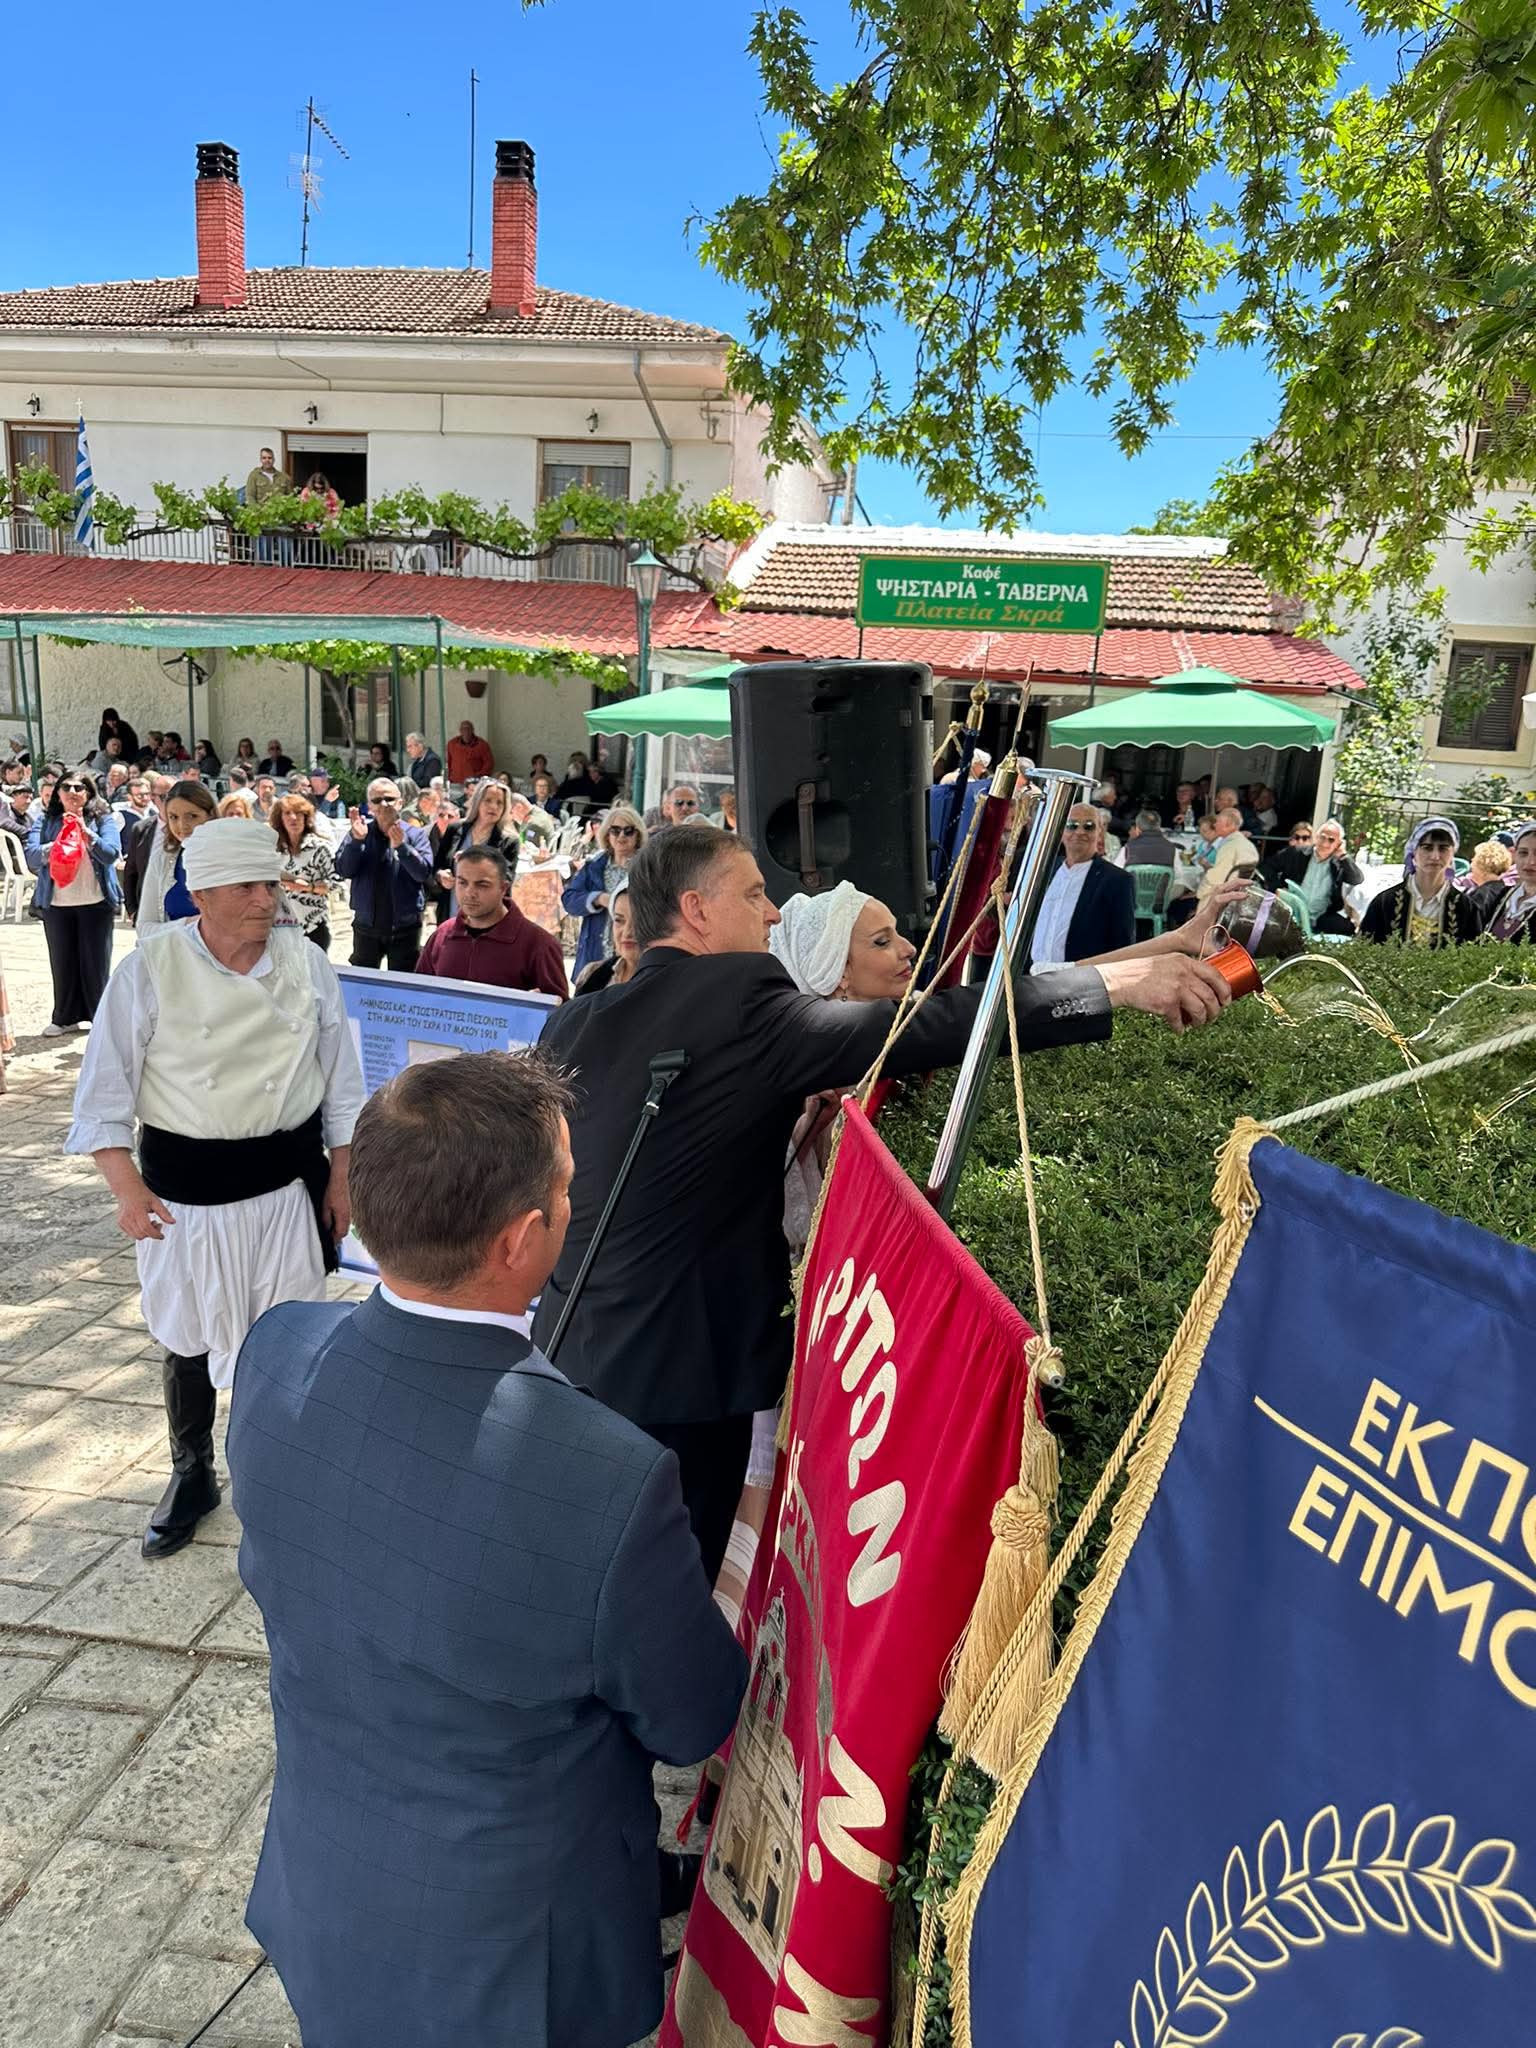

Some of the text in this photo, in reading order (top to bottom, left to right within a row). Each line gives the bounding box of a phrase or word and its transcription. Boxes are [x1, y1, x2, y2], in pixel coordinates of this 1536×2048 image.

[962, 565, 1001, 581] Καφέ
[876, 579, 977, 599] ΨΗΣΤΑΡΙΑ
[997, 583, 1089, 602] ΤΑΒΕΡΝΑ
[895, 601, 1064, 626] Πλατεία Σκρά
[407, 1018, 422, 1029] ΤΟΥ
[443, 1023, 453, 1032] 17
[1350, 1377, 1536, 1566] ΕΚΠ
